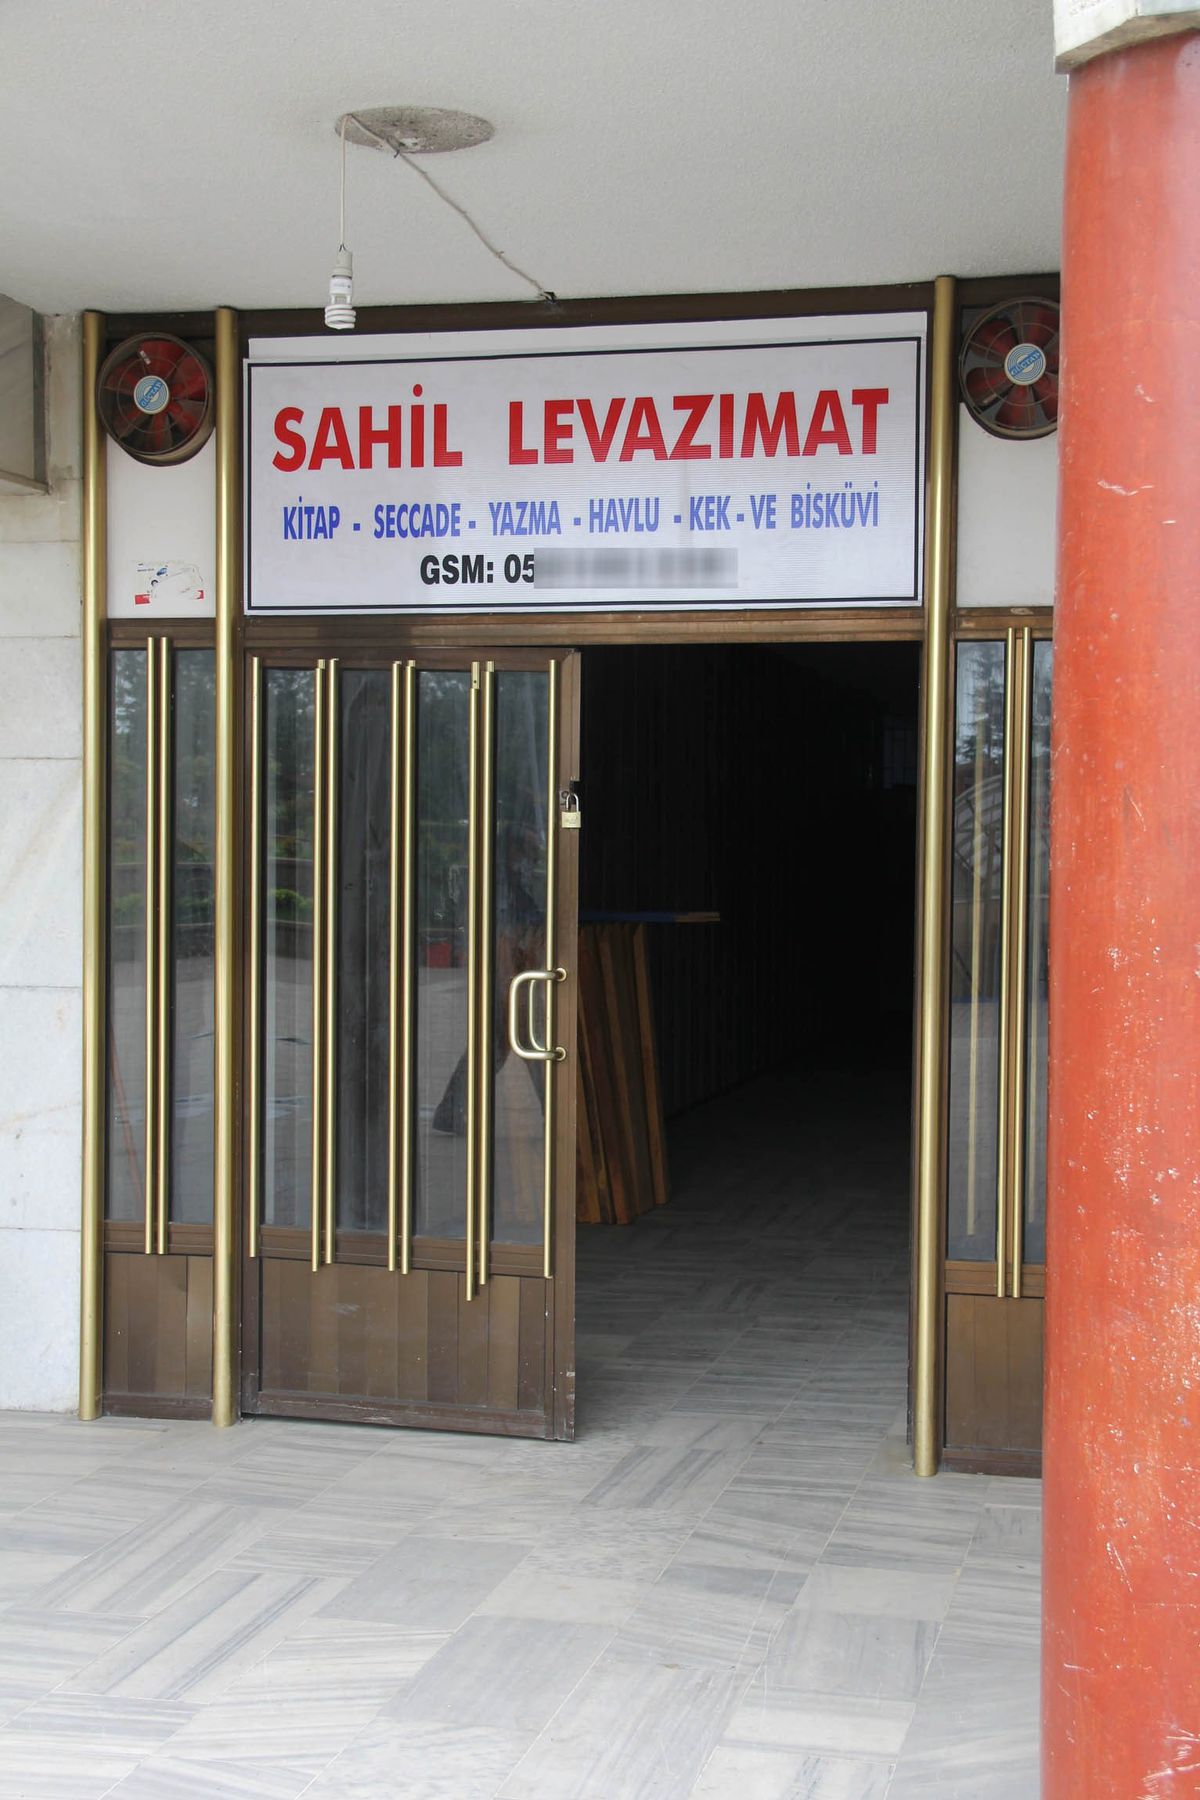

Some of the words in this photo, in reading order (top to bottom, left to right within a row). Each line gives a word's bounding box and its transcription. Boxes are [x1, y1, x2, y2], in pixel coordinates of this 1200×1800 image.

[272, 383, 463, 473] SAHİL
[508, 388, 890, 465] LEVAZIMAT
[283, 495, 341, 540] KİTAP
[373, 502, 462, 540] SECCADE
[488, 500, 562, 536] YAZMA
[588, 496, 661, 533] HAVLU
[689, 495, 732, 531] KEK
[749, 493, 778, 529] VE
[790, 480, 880, 529] BİSKÜVİ
[420, 554, 494, 585] GSM:
